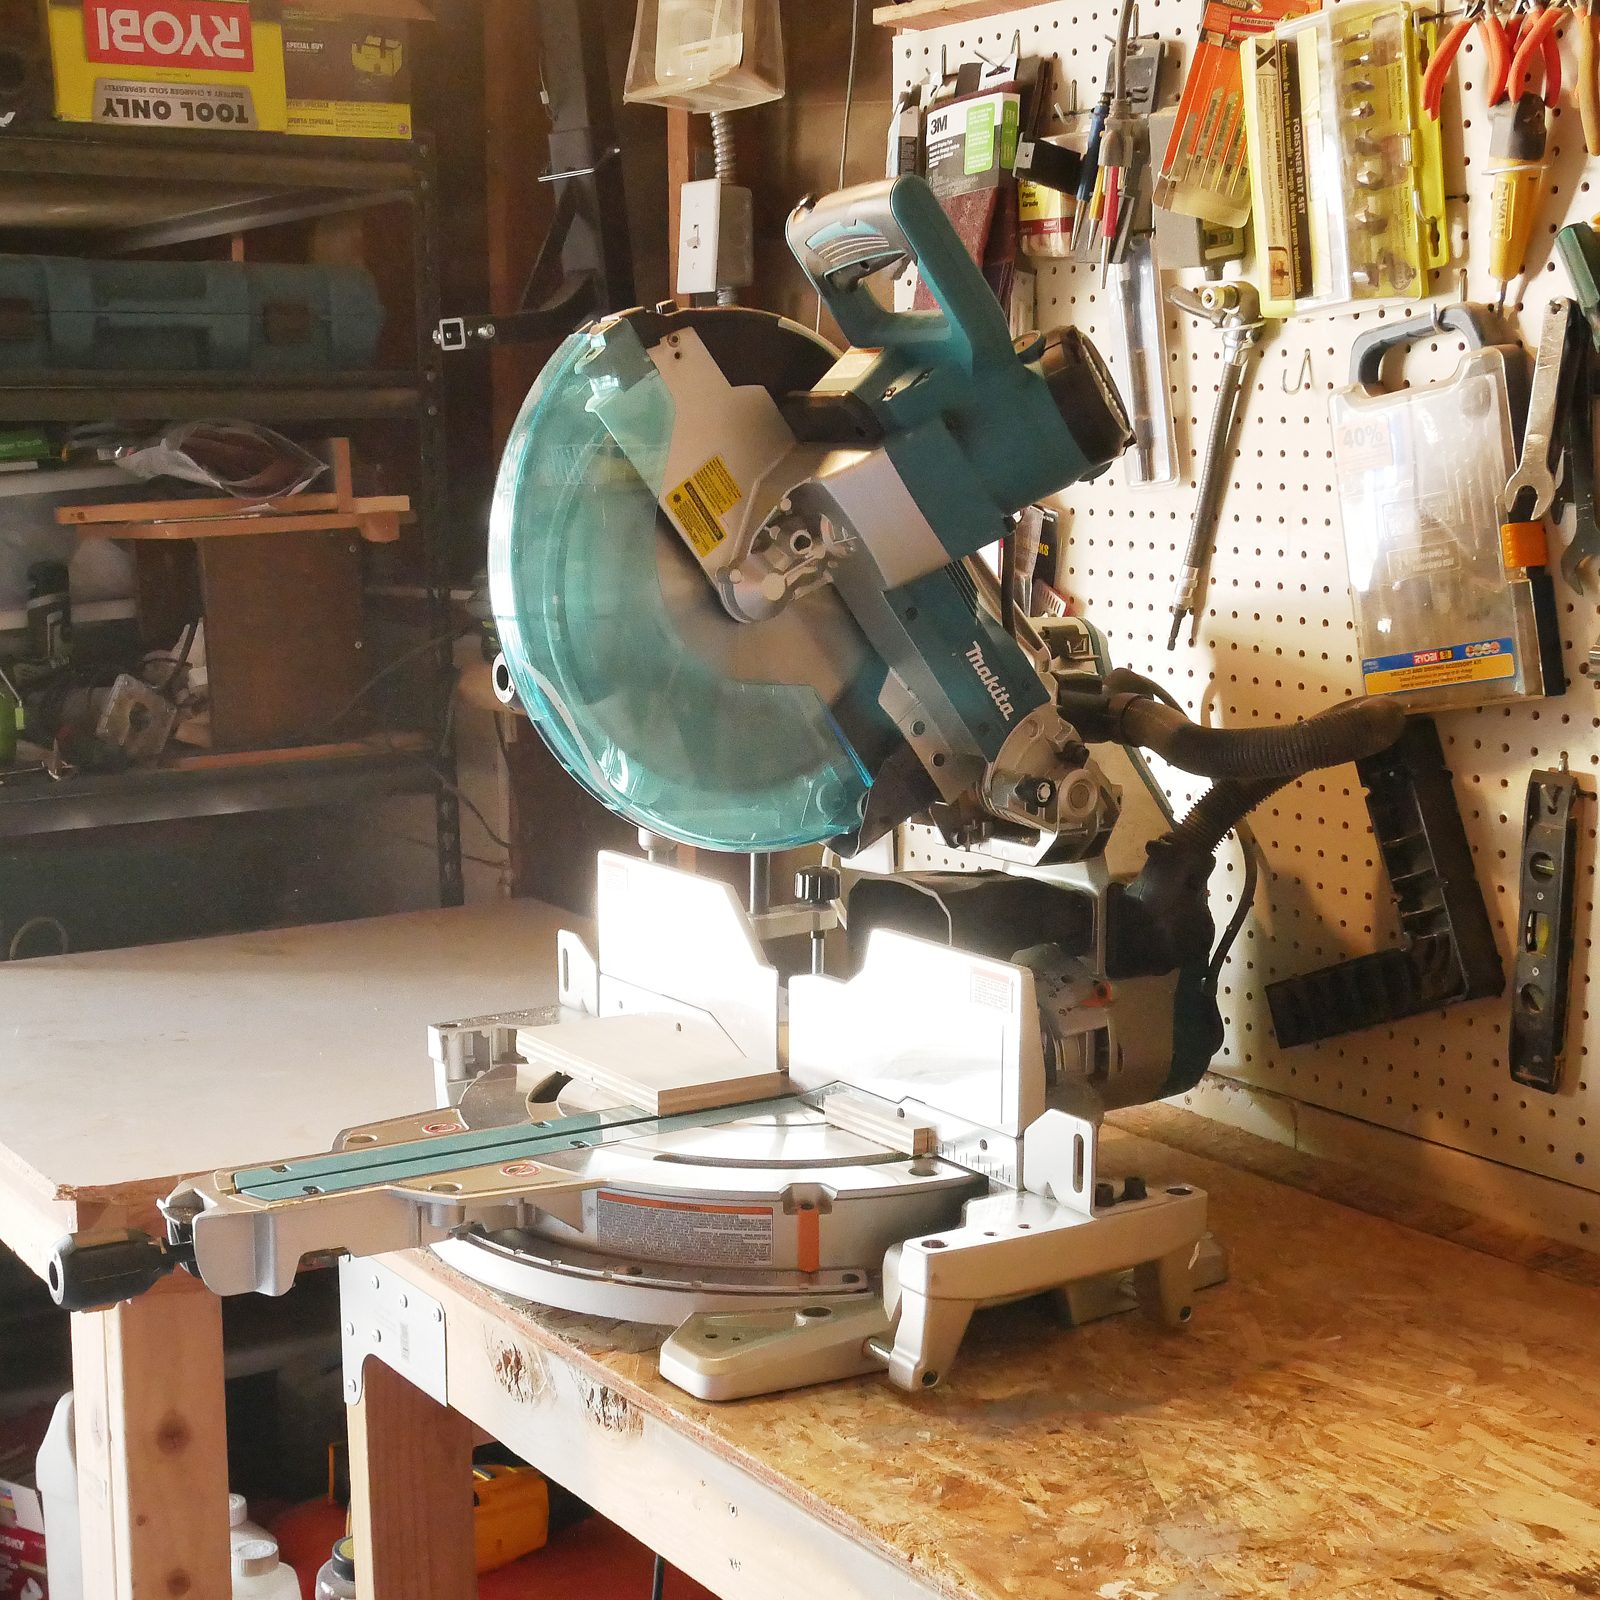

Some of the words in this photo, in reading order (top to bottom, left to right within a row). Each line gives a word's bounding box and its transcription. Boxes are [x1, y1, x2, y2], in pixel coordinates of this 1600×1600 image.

[1239, 16, 1274, 27] Clearance
[97, 8, 245, 59] RYOBI
[104, 84, 148, 95] SEPARATELY
[149, 86, 169, 96] SOLD
[170, 87, 205, 97] CHARGER
[102, 98, 172, 121] ONLY
[180, 101, 249, 124] TOOL
[930, 114, 948, 136] 3M
[1292, 118, 1303, 173] FORSTNER
[1296, 176, 1304, 193] BIT
[1298, 197, 1306, 214] SET
[1343, 424, 1383, 448] 40%
[1038, 542, 1049, 556] KS
[1413, 652, 1438, 664] RYOBI
